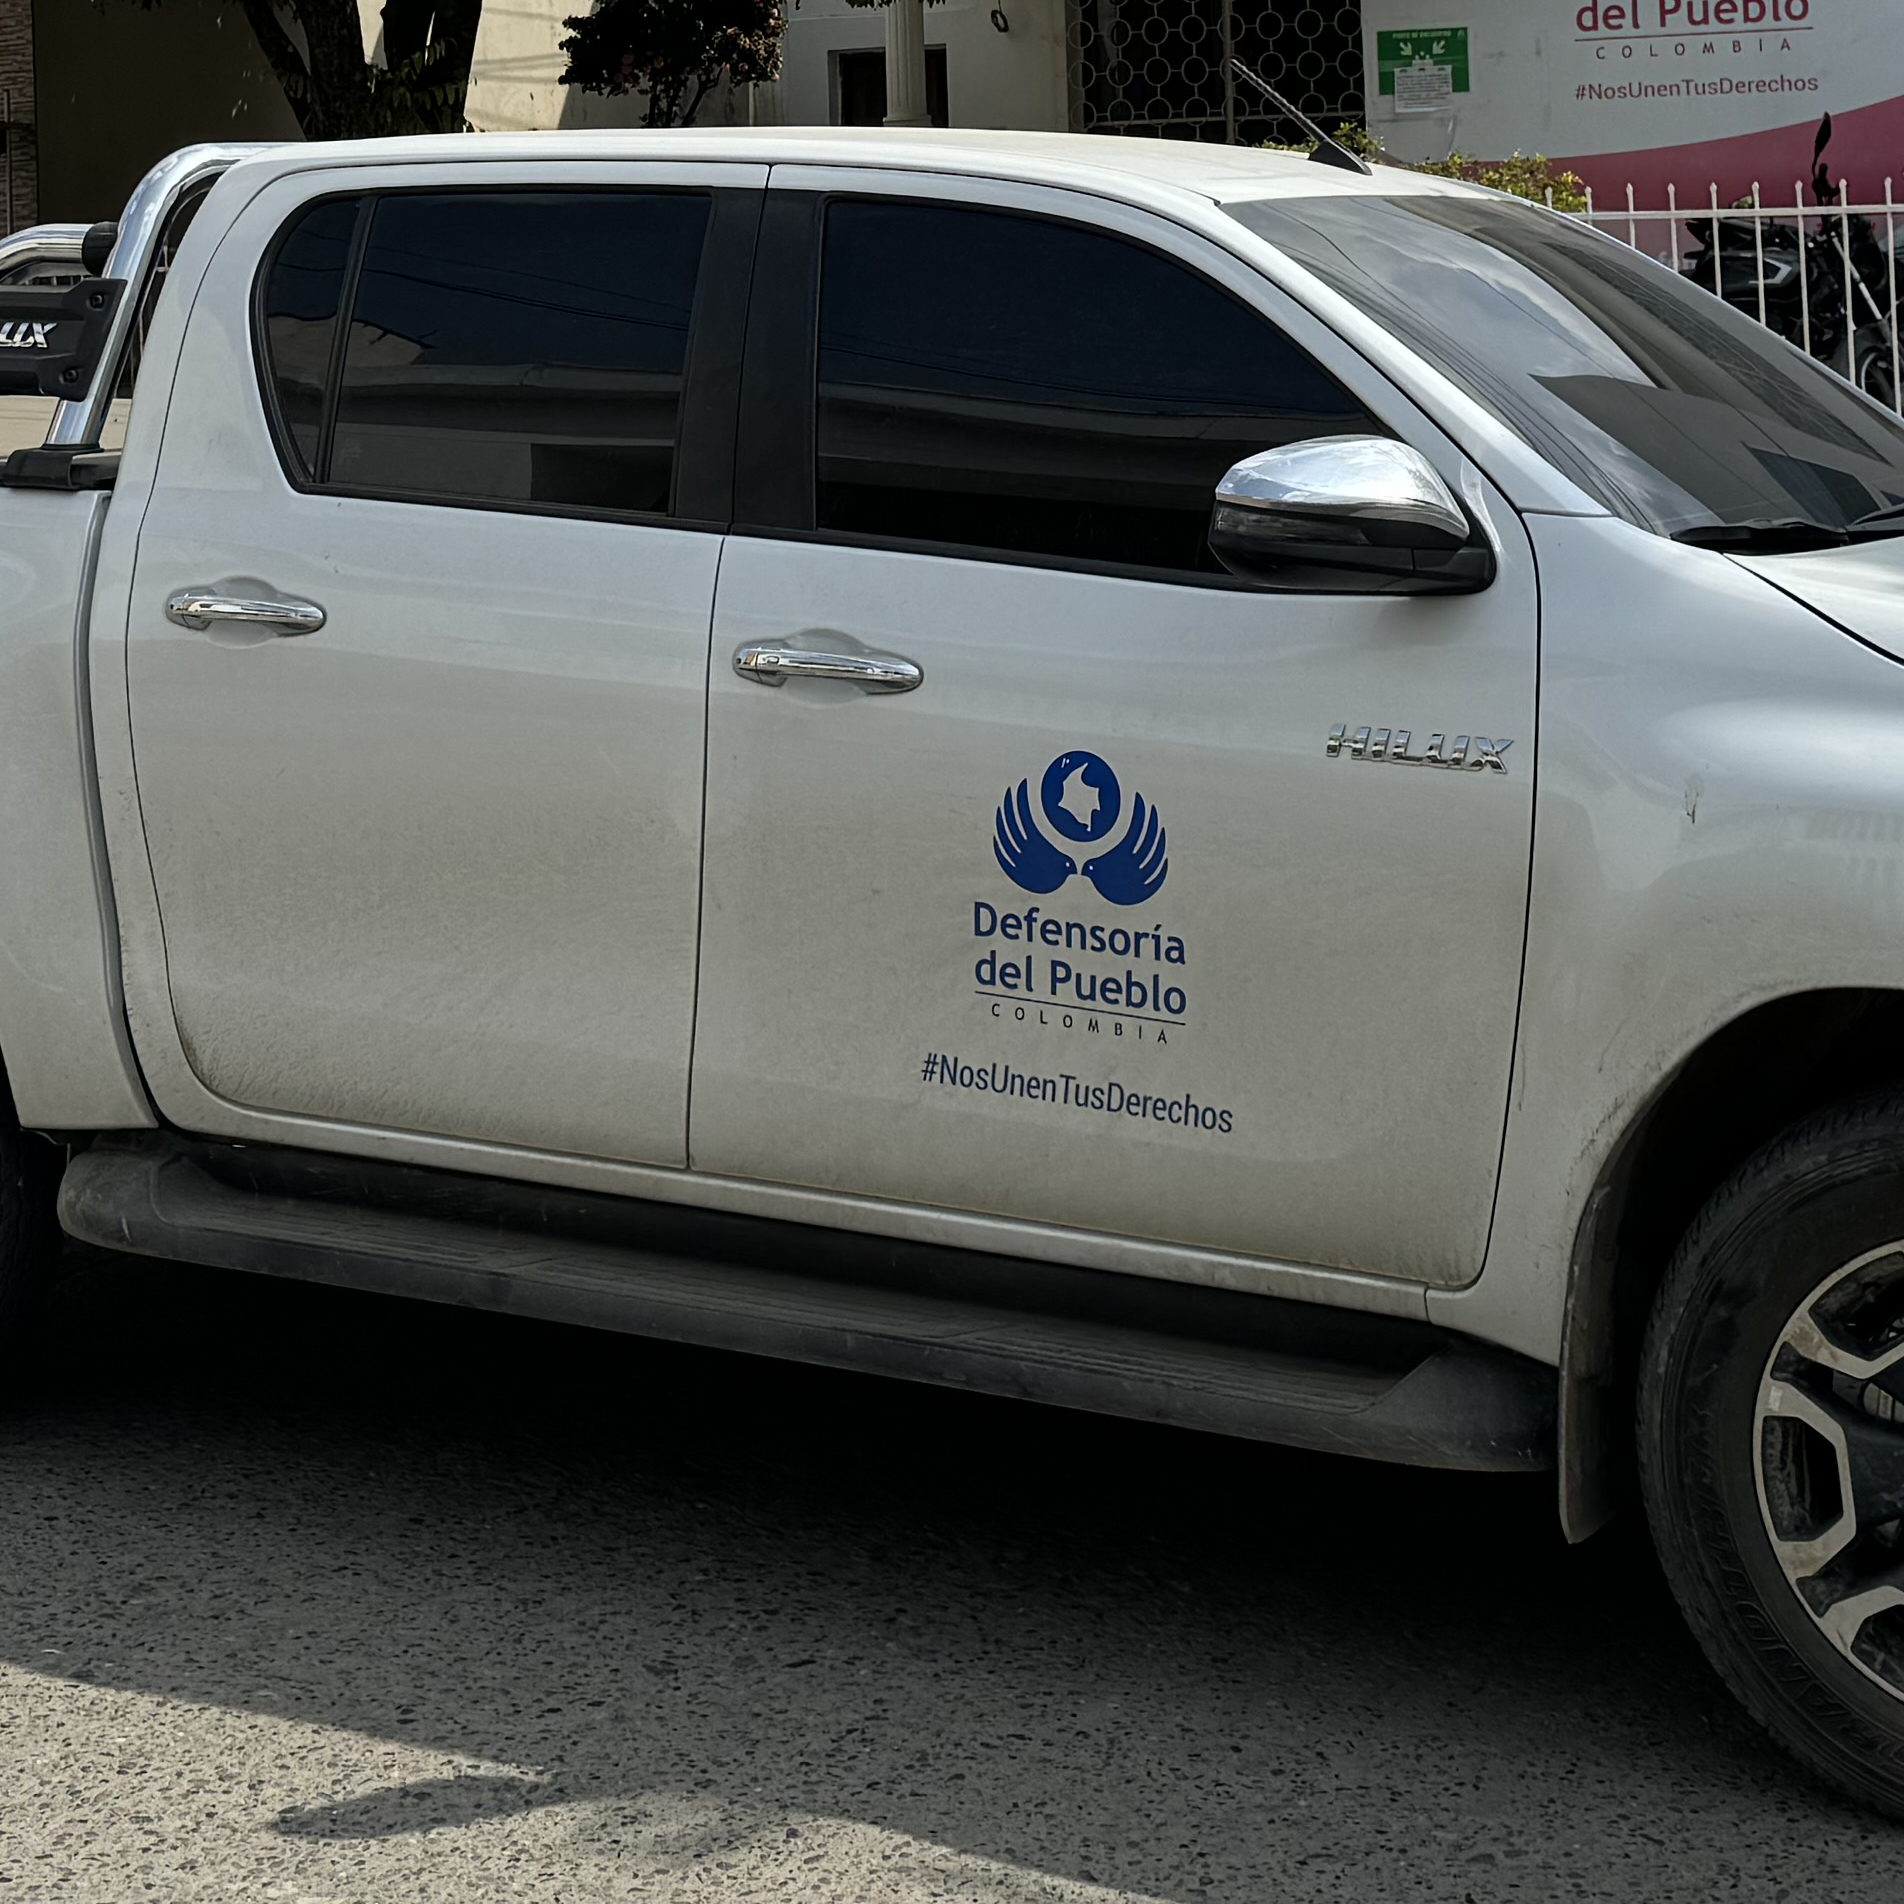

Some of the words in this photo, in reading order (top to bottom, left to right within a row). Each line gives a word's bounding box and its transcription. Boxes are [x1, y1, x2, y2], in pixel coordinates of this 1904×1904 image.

[1596, 38, 1791, 60] COLOMBIA
[1575, 75, 1819, 101] #NosUnenTusDerechos
[1326, 723, 1515, 774] HILUX
[973, 900, 1186, 965] Defensoría
[974, 949, 1034, 992] del
[1049, 958, 1187, 1015] Pueblo
[991, 1003, 1168, 1045] COLOMBIA
[920, 1052, 1233, 1134] #NosUnenTusDerechos
